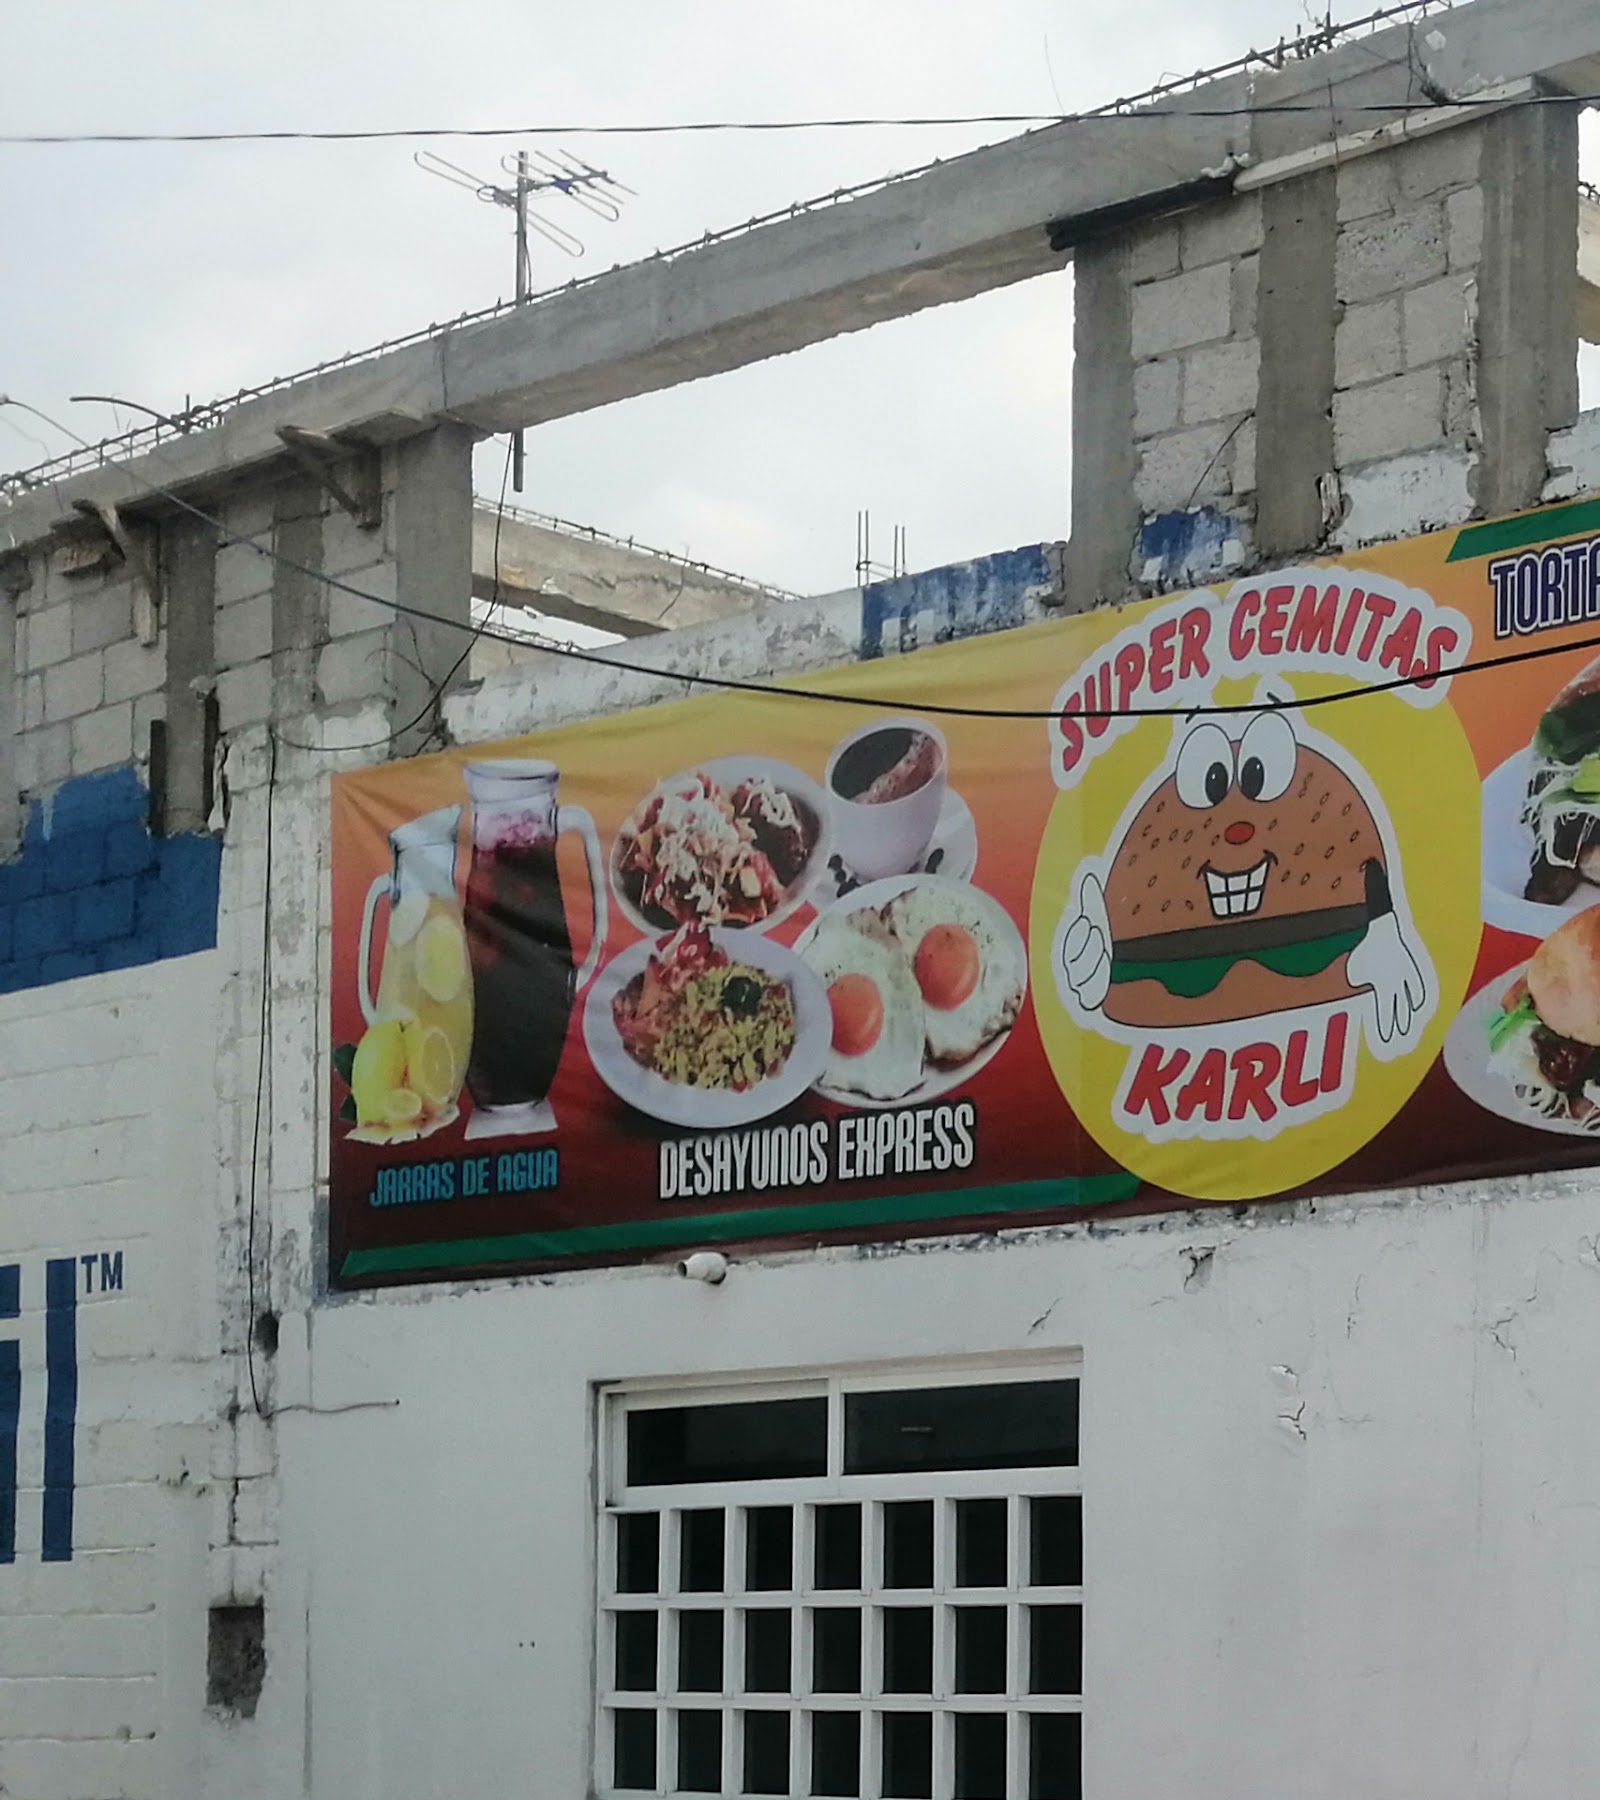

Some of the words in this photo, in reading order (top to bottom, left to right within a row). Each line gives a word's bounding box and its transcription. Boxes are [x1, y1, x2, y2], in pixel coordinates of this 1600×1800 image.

[1060, 606, 1212, 772] SUPER
[1228, 584, 1458, 689] CEMITAS
[1123, 1011, 1348, 1125] KARLI
[370, 1162, 455, 1207] JARRAS
[462, 1158, 490, 1196] DE
[497, 1148, 558, 1191] AGUA
[659, 1120, 828, 1199] DESAYUNOS
[838, 1103, 975, 1180] EXPRESS
